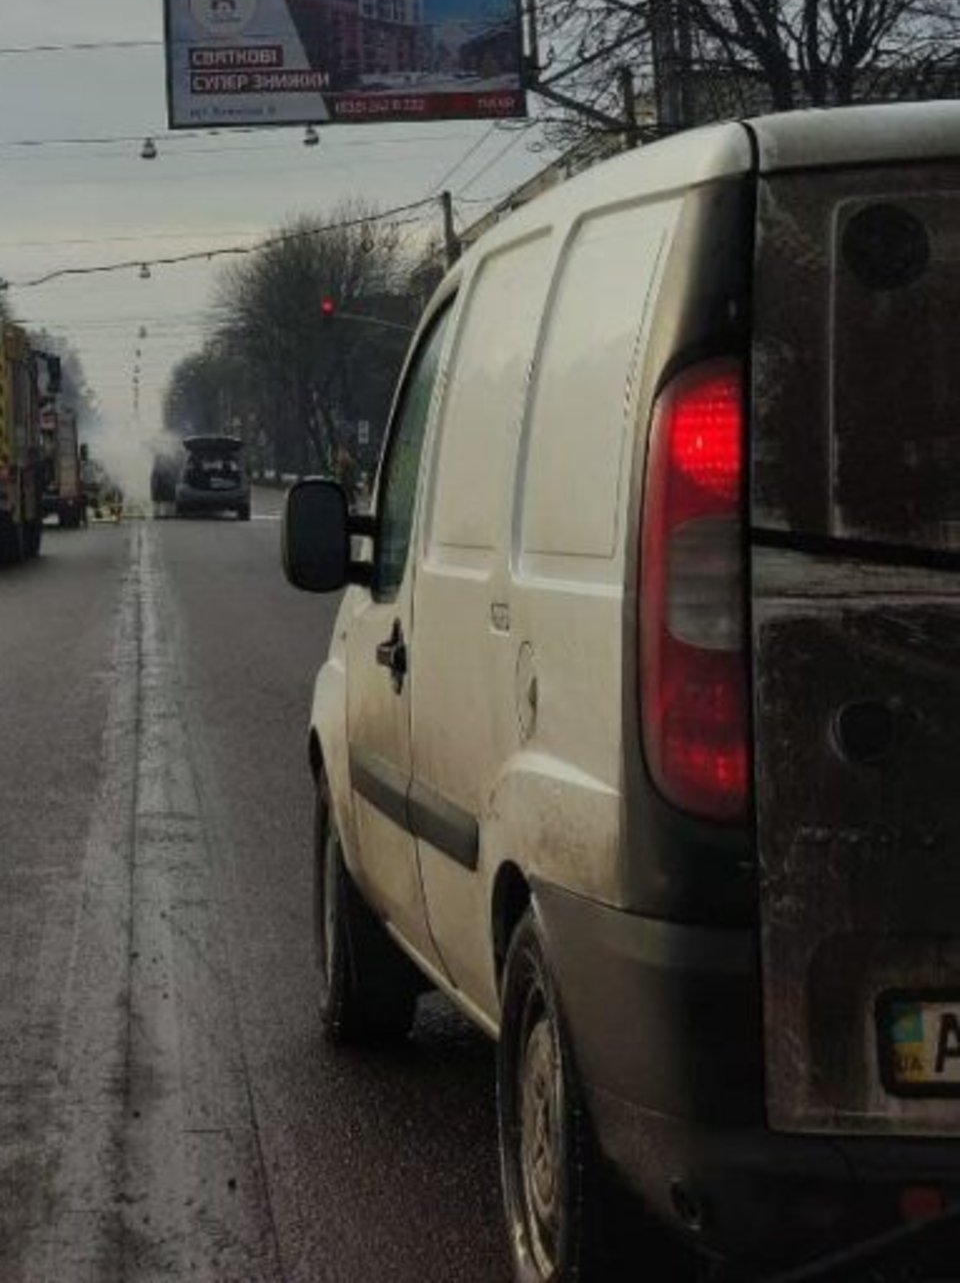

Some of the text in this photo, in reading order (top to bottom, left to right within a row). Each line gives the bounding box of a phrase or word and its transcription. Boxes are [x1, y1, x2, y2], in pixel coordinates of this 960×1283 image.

[192, 49, 278, 66] СВЯТКОВІ
[192, 71, 330, 91] СУПЕР ЗНИЖКИ
[895, 1054, 924, 1072] UA
